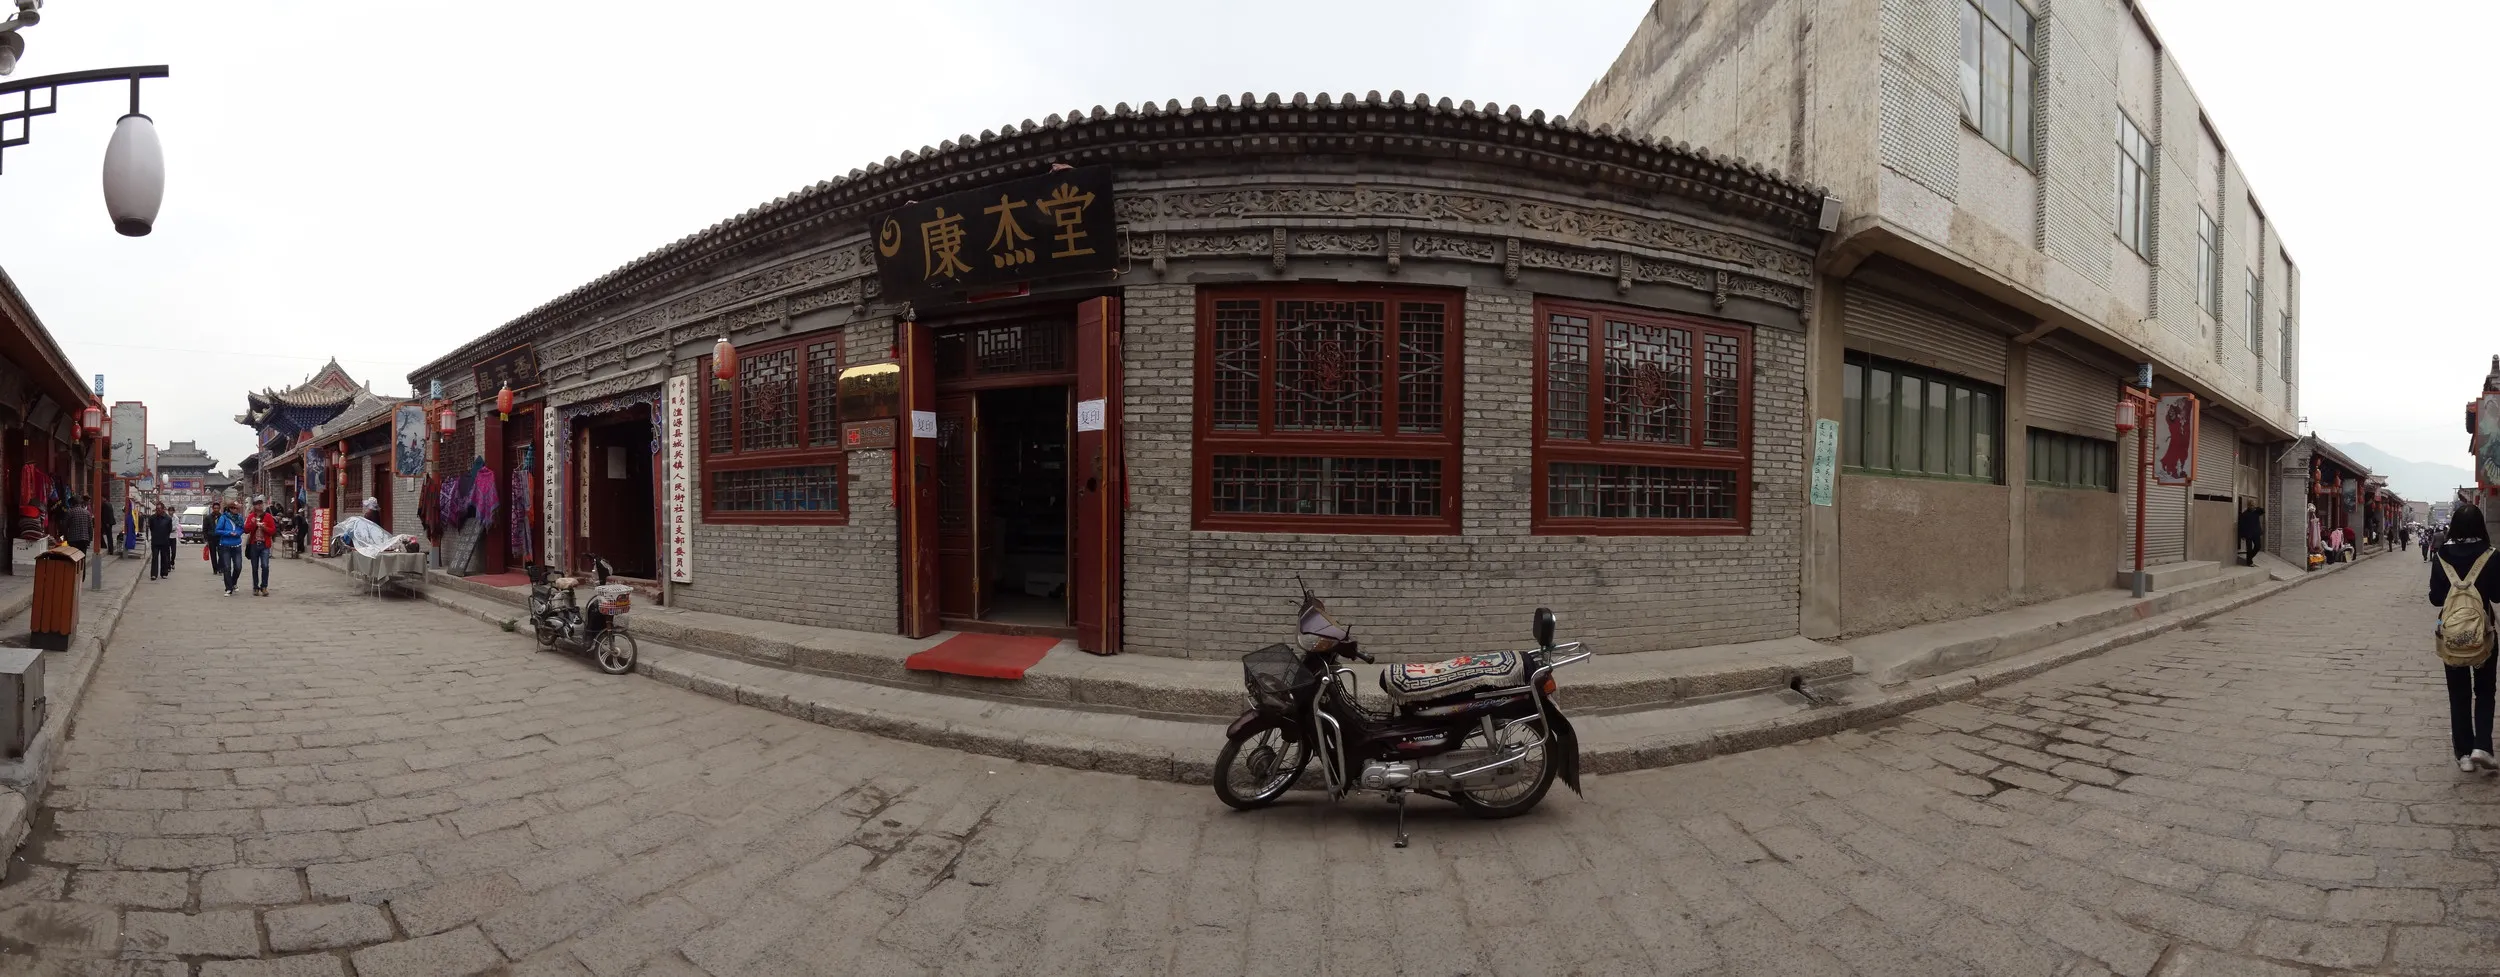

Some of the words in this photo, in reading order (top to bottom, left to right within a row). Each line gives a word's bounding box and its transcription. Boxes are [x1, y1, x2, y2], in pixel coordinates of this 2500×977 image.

[920, 183, 1096, 281] 康杰堂
[917, 418, 933, 432] 复印
[1081, 410, 1100, 425] 复印
[313, 509, 323, 552] 青海风味小吃
